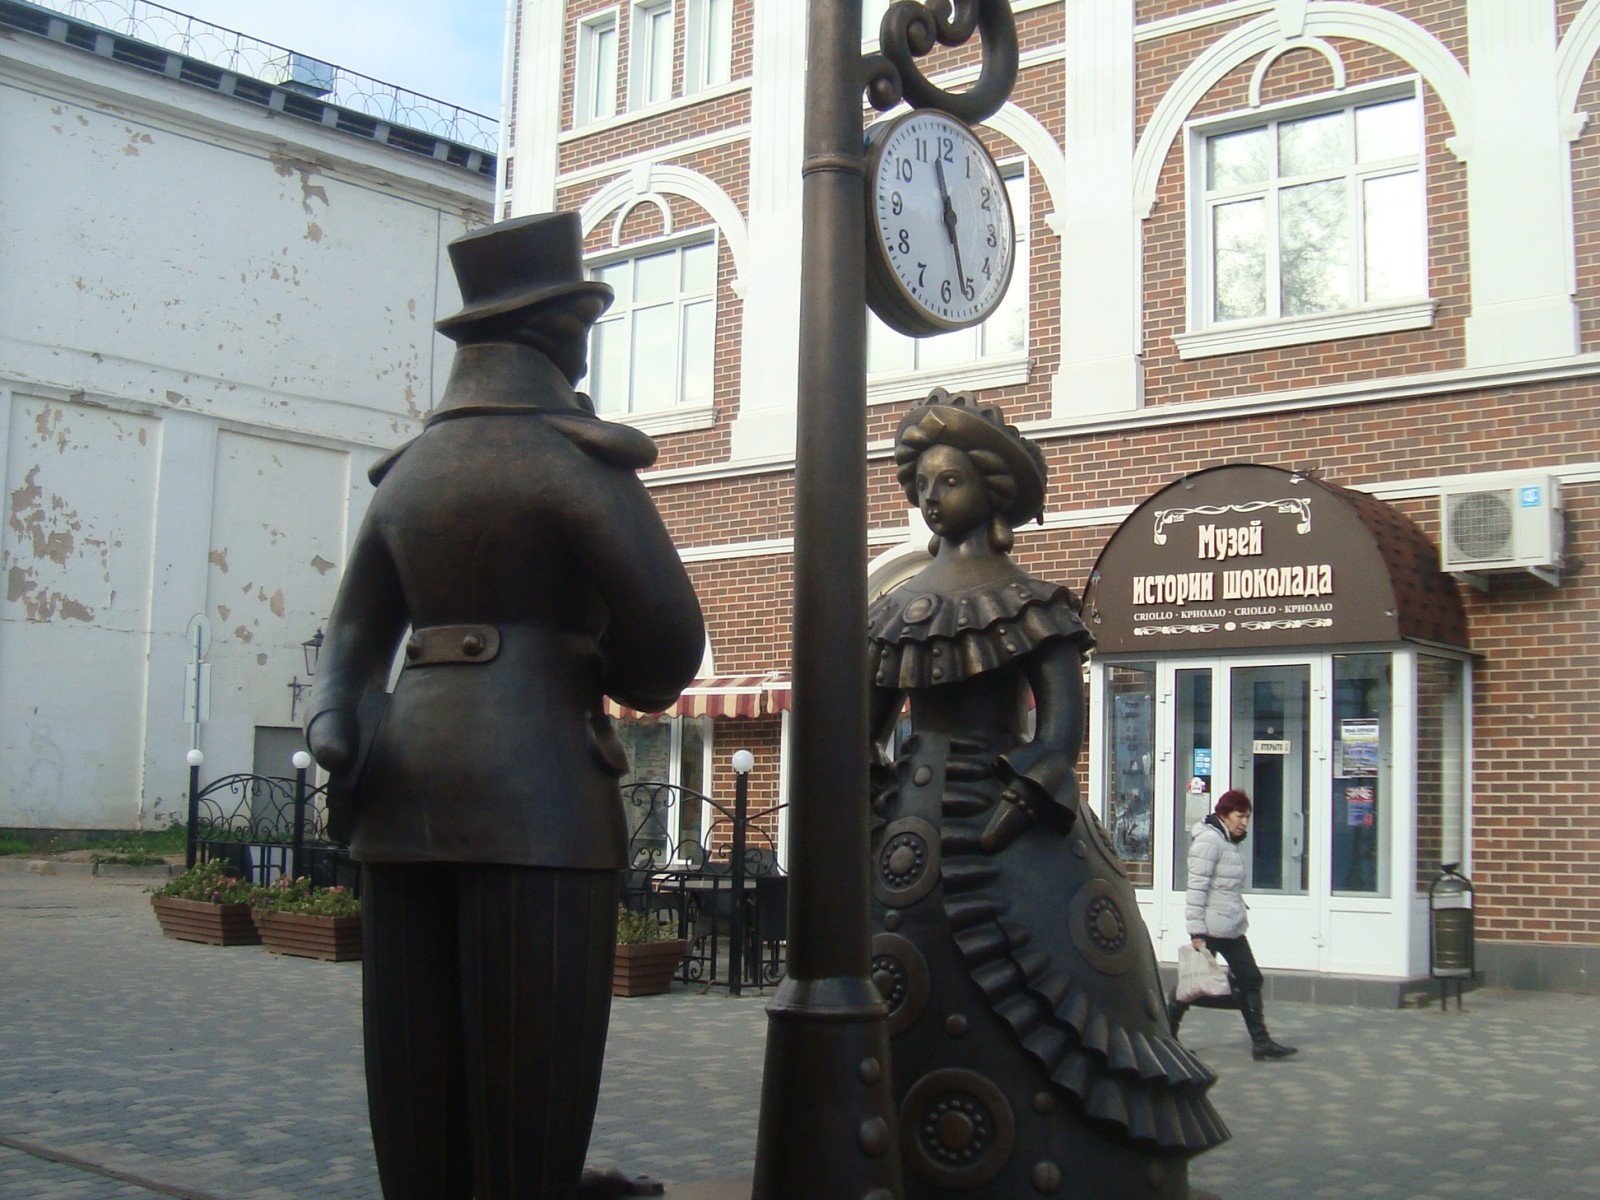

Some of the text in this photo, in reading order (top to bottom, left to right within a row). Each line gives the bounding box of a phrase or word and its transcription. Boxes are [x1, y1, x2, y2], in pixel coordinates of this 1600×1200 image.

[915, 138, 928, 164] 11
[936, 136, 954, 163] 12
[895, 157, 912, 183] 10
[964, 155, 971, 179] 1
[891, 191, 903, 216] 9
[980, 186, 991, 213] 2
[899, 229, 910, 254] 8
[986, 224, 997, 248] 3
[917, 262, 927, 288] 7
[981, 256, 991, 281] 4
[941, 279, 951, 304] 6
[964, 278, 975, 301] 5
[1197, 520, 1264, 560] Музей
[1222, 564, 1333, 598] шоколада
[1133, 611, 1173, 621] CRIOLLO
[1234, 606, 1276, 616] CRIOLLO
